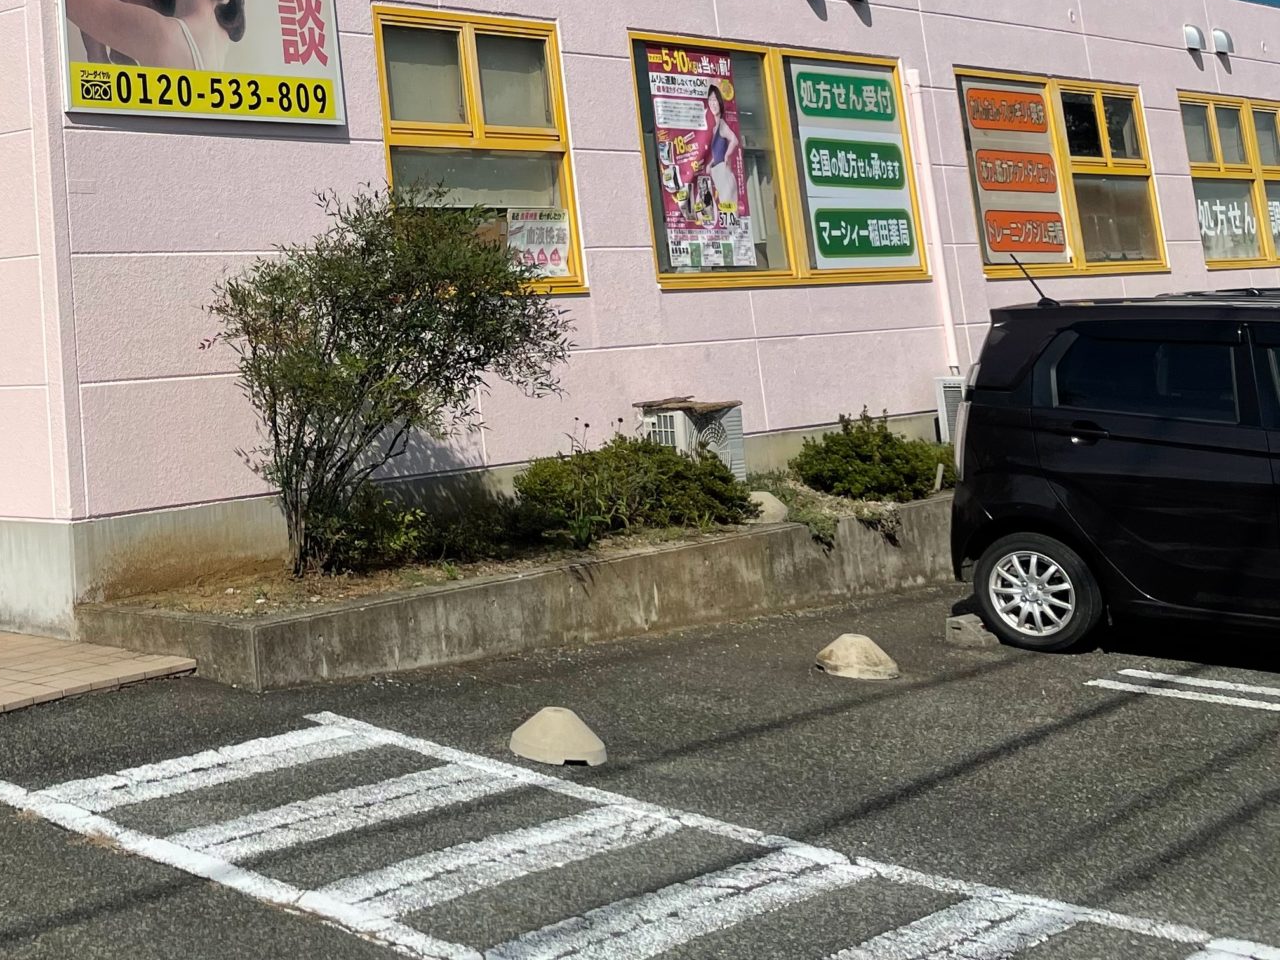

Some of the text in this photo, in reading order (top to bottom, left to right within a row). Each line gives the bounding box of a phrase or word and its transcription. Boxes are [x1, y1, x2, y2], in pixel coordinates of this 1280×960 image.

[80, 69, 327, 114] フリーダイヤル 0120-533-809
[800, 79, 892, 114] 処方せん受付
[809, 148, 900, 180] 全国の処方せん承ります
[819, 219, 911, 247] マーシィー稲田薬局
[987, 219, 1065, 246] トレーニングジム完備
